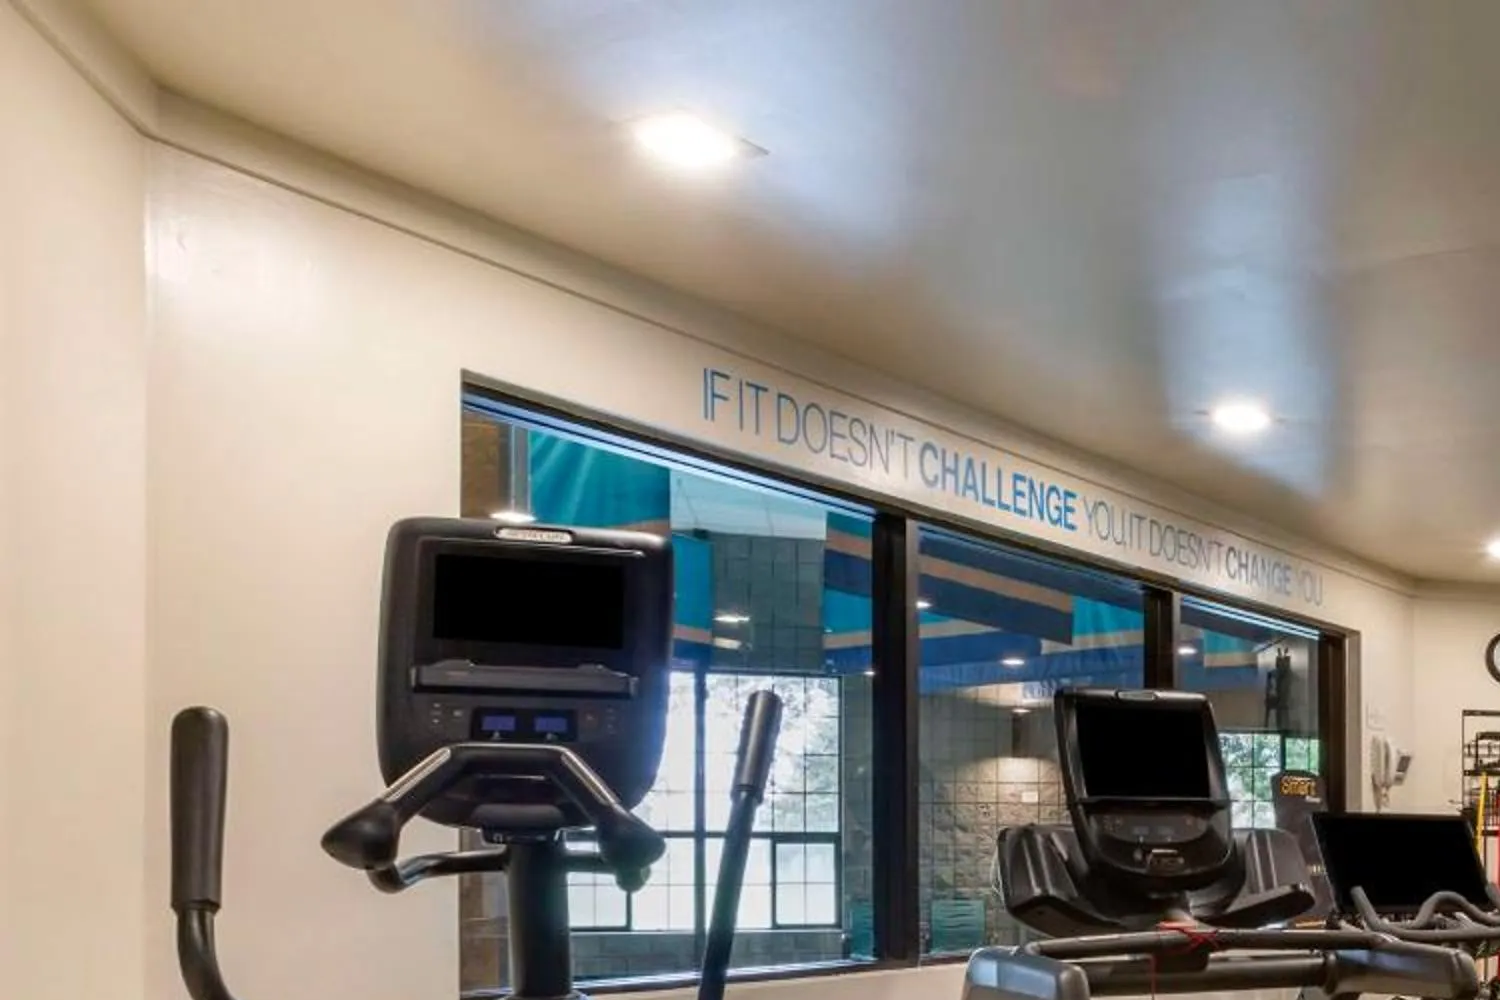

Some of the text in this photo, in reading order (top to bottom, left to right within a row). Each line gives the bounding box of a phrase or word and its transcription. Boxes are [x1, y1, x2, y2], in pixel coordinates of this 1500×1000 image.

[703, 367, 732, 422] IF
[738, 379, 769, 435] IT
[776, 392, 916, 481] DOESN'T
[919, 442, 1077, 531] CHALLENGE
[1149, 519, 1224, 575] DOESN'T
[1225, 545, 1292, 597] CHANGE
